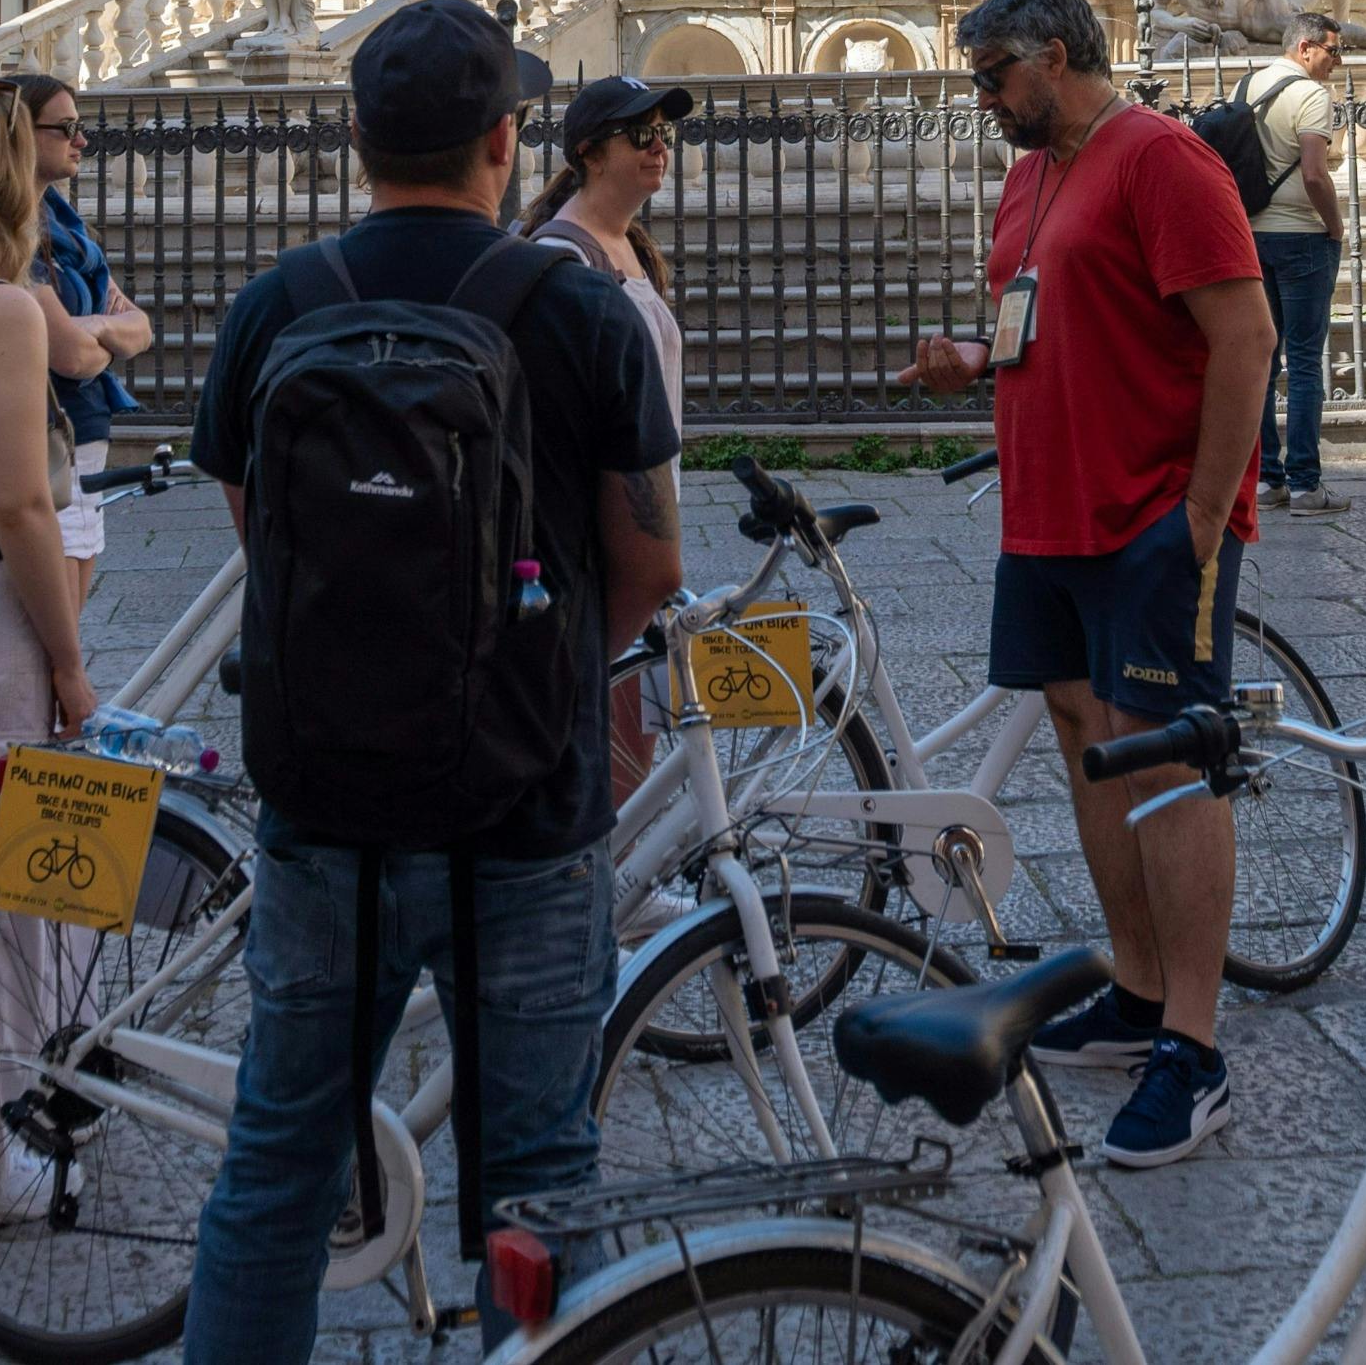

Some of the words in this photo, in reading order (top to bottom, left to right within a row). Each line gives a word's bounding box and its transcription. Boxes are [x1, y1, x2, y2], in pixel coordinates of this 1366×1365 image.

[766, 617, 800, 631] BIKE
[702, 635, 724, 644] BIKE
[709, 645, 731, 655] BIKE
[10, 766, 84, 790] PALERMO
[85, 780, 108, 796] ON
[111, 782, 149, 803] BIKE
[36, 793, 60, 808] BIKE
[60, 799, 69, 809] &
[71, 800, 111, 817] RENTAL
[40, 808, 64, 823] BIKE
[67, 813, 102, 829] TOURS
